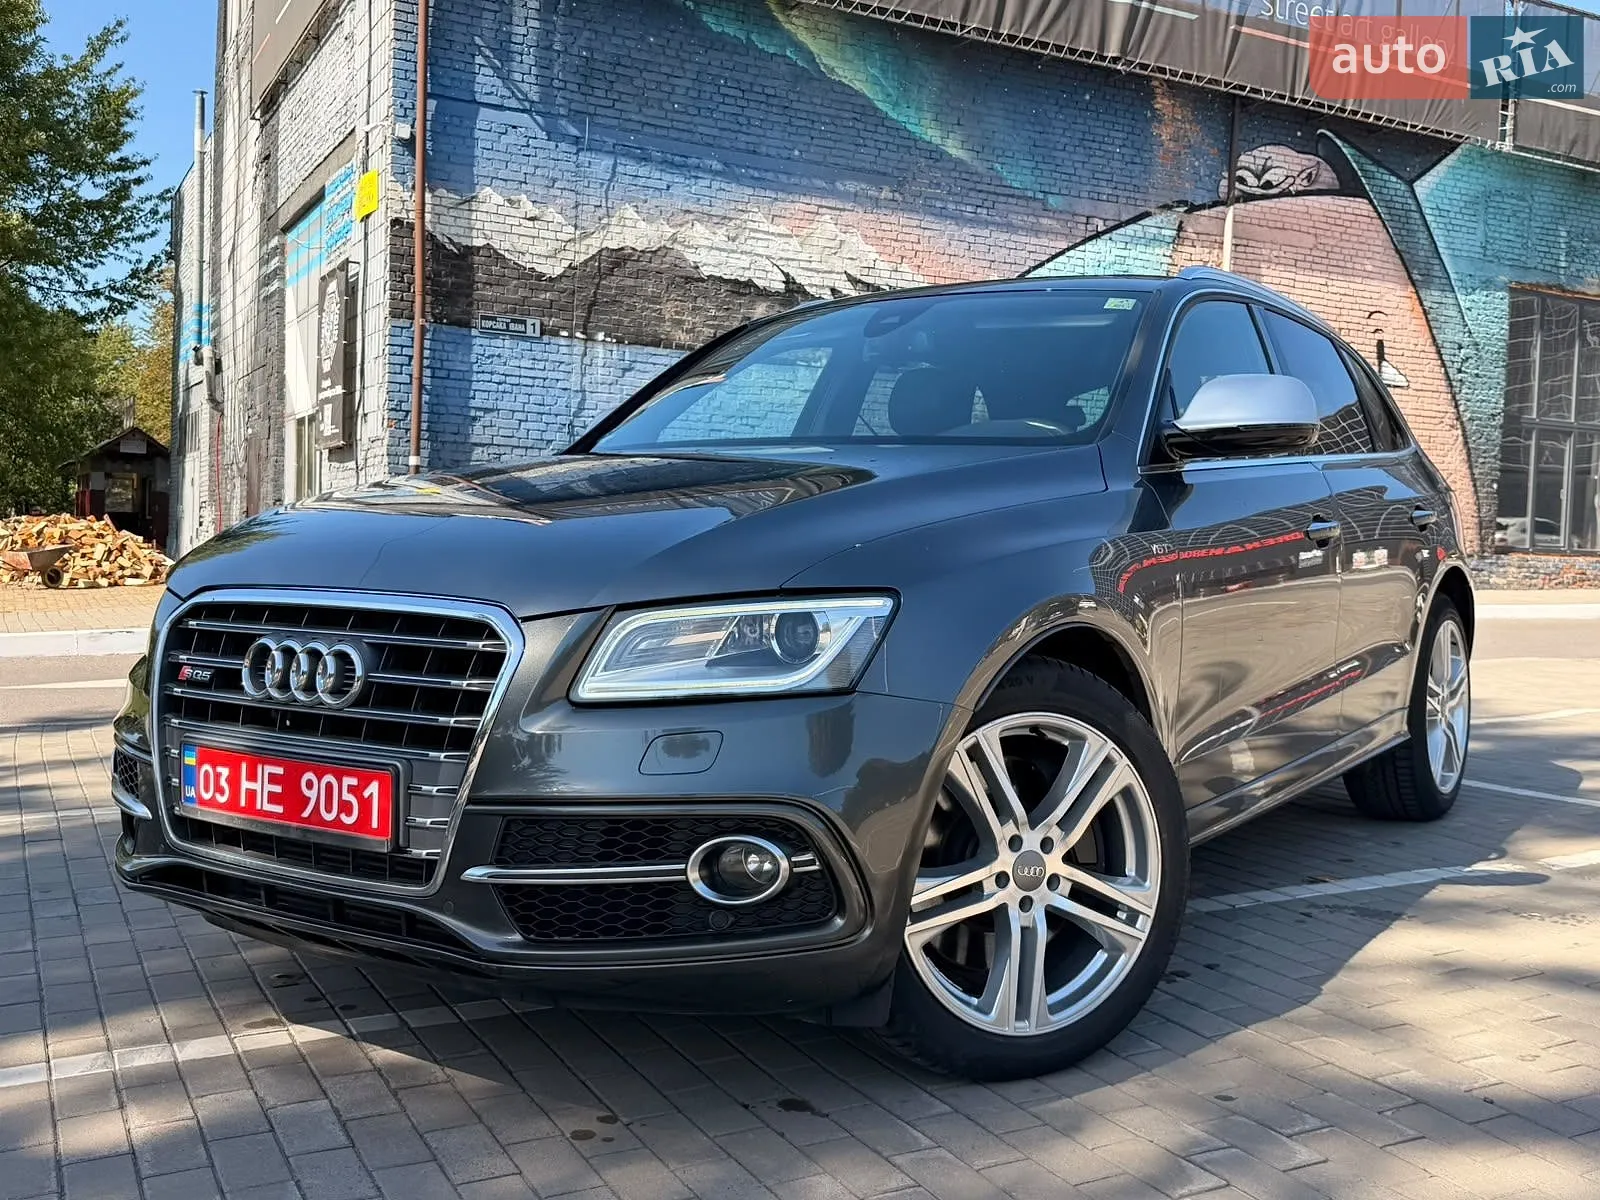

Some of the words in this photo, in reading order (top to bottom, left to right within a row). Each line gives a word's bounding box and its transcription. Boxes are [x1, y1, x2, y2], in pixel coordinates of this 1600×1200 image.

[1261, 0, 1334, 31] street
[1341, 15, 1374, 43] art
[530, 322, 536, 334] 1
[178, 665, 212, 680] SQ5
[185, 785, 196, 799] UA
[199, 763, 230, 804] 03
[240, 761, 284, 814] HE
[300, 771, 379, 829] 9051
